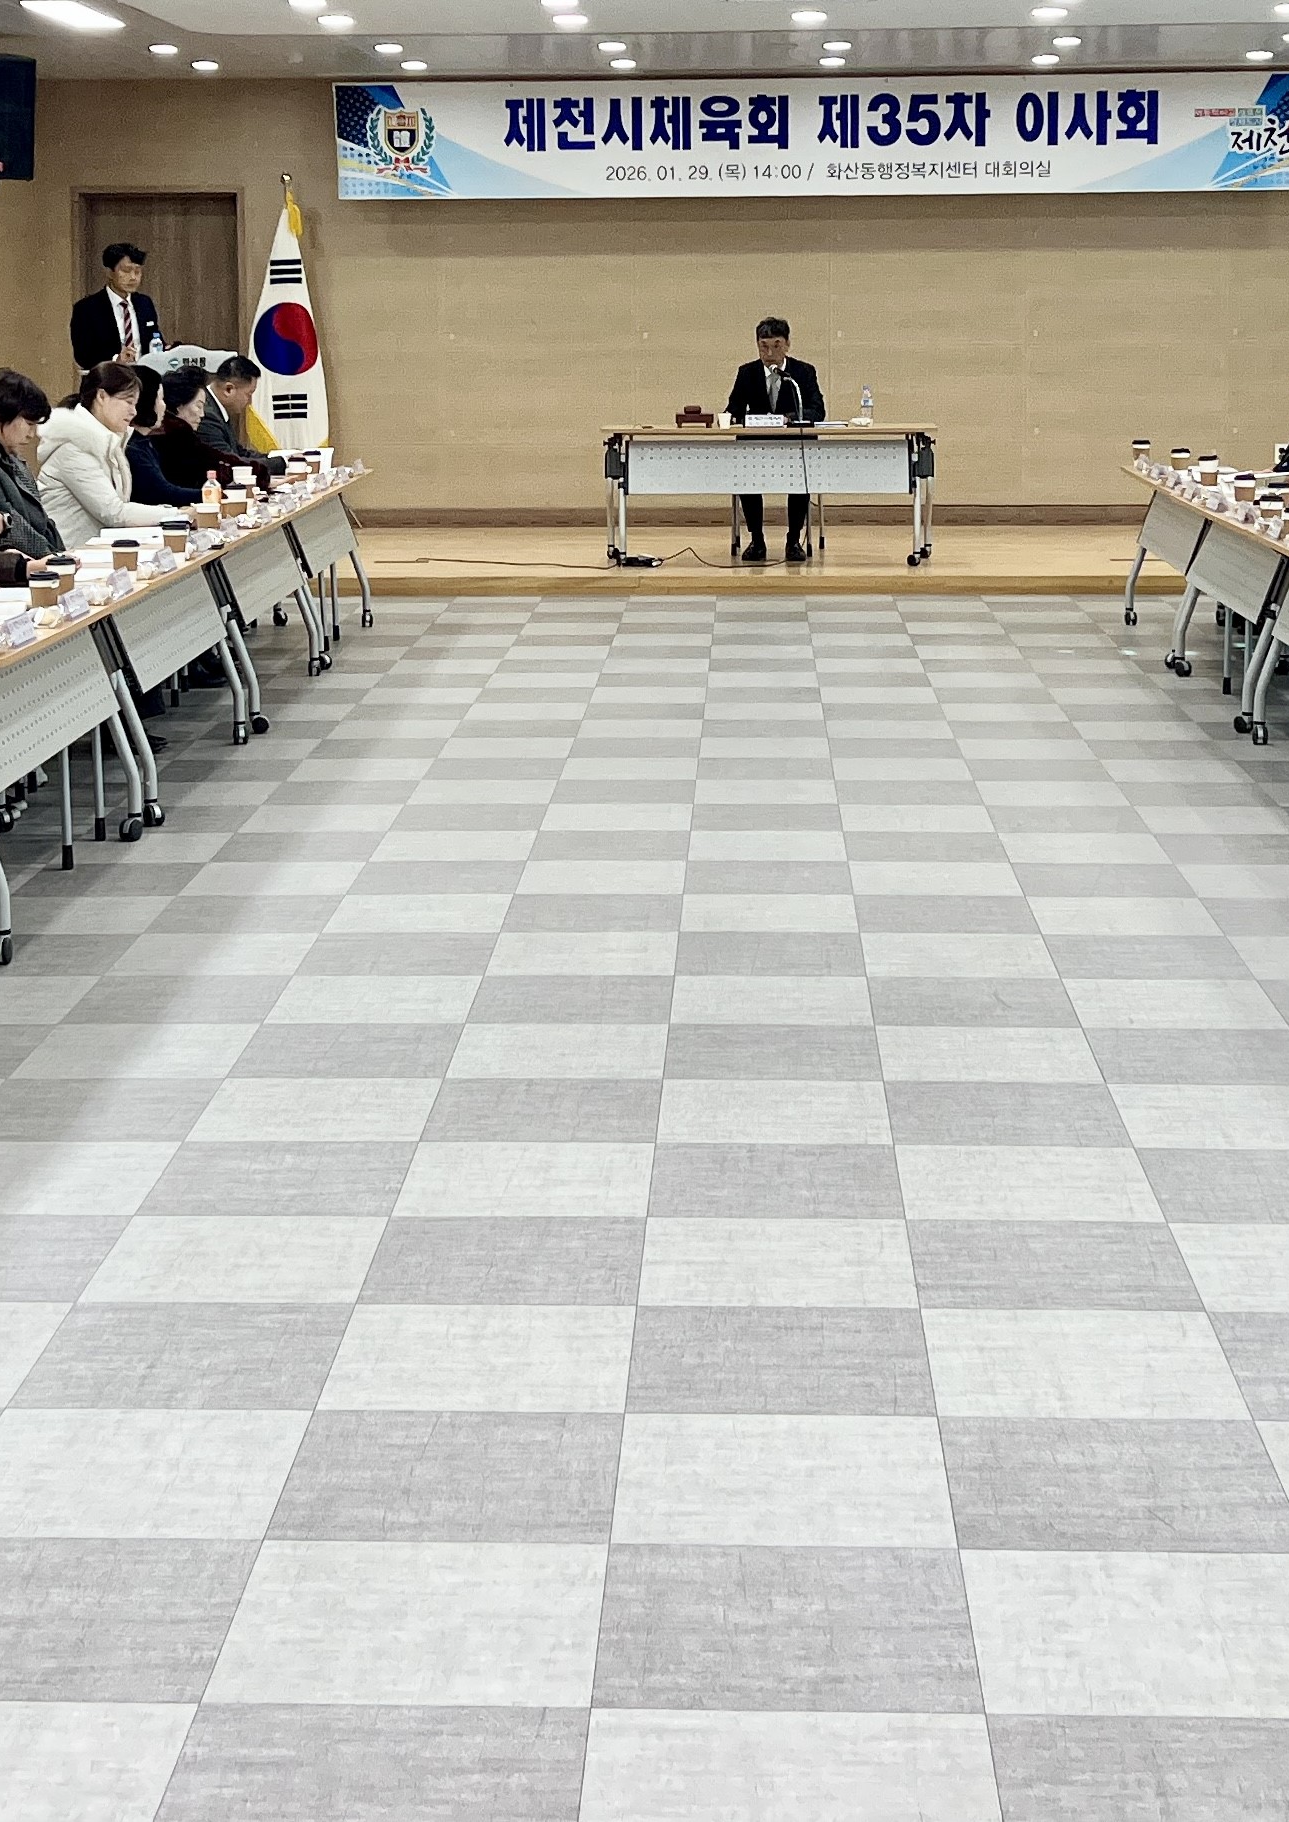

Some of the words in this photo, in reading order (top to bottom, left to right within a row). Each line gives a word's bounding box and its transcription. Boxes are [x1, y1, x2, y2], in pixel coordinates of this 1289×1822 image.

[503, 94, 789, 152] 제천시체육회
[816, 91, 991, 149] 제35차
[1015, 88, 1160, 146] 이사회
[605, 164, 652, 182] 2026.
[656, 165, 682, 182] 01.
[688, 164, 713, 181] 29.
[718, 163, 746, 181] (목)
[753, 163, 802, 180] 14:00
[826, 161, 978, 180] 화산동행정복지센터
[985, 159, 1051, 179] 대회의실
